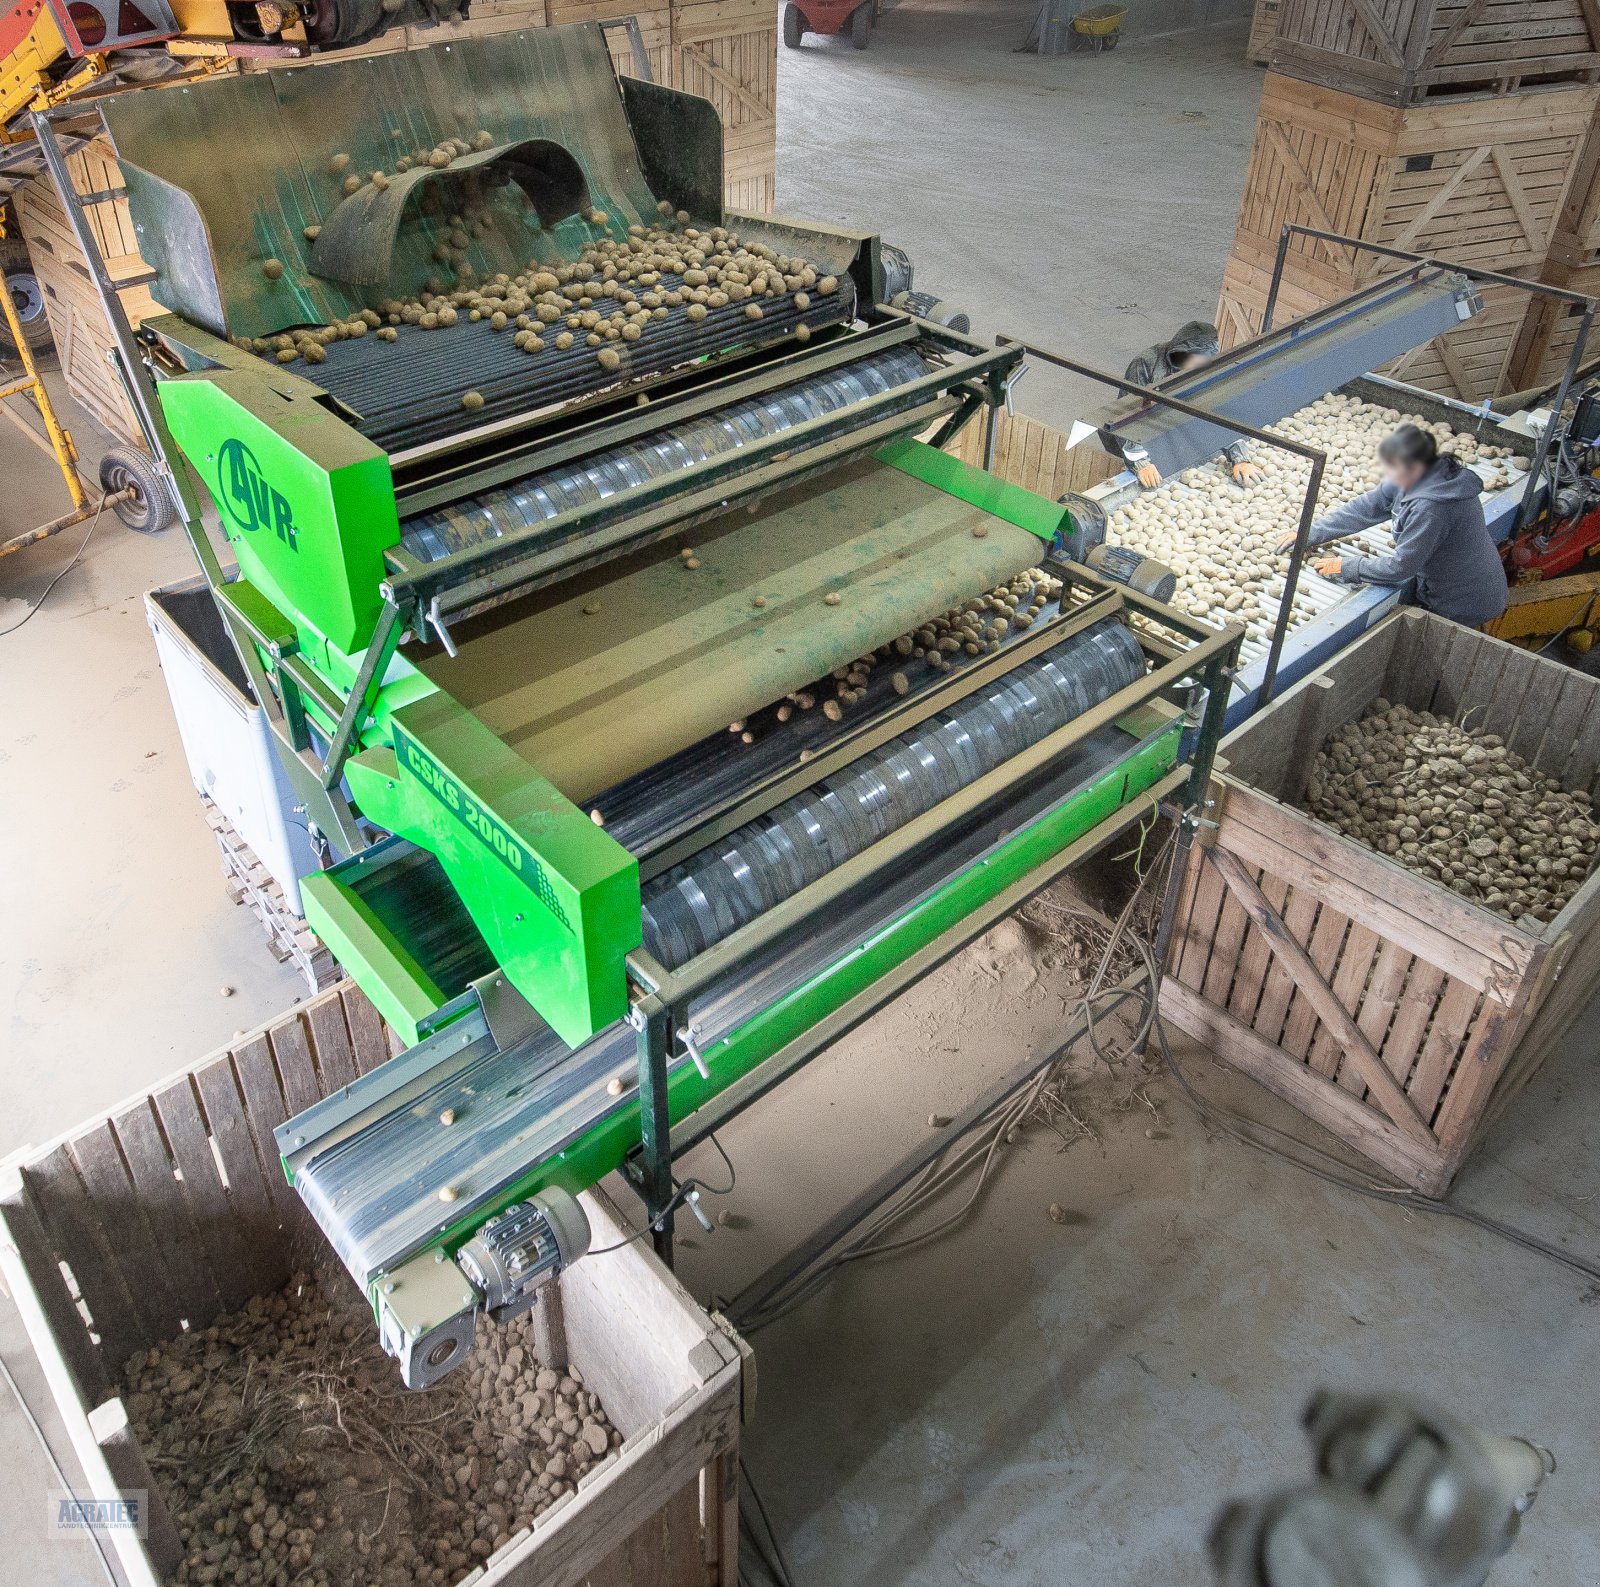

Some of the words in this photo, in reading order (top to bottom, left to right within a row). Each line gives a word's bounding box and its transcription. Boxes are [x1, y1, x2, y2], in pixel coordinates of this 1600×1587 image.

[218, 438, 298, 554] AVR
[407, 745, 460, 811] CSKS
[465, 801, 522, 871] 2000
